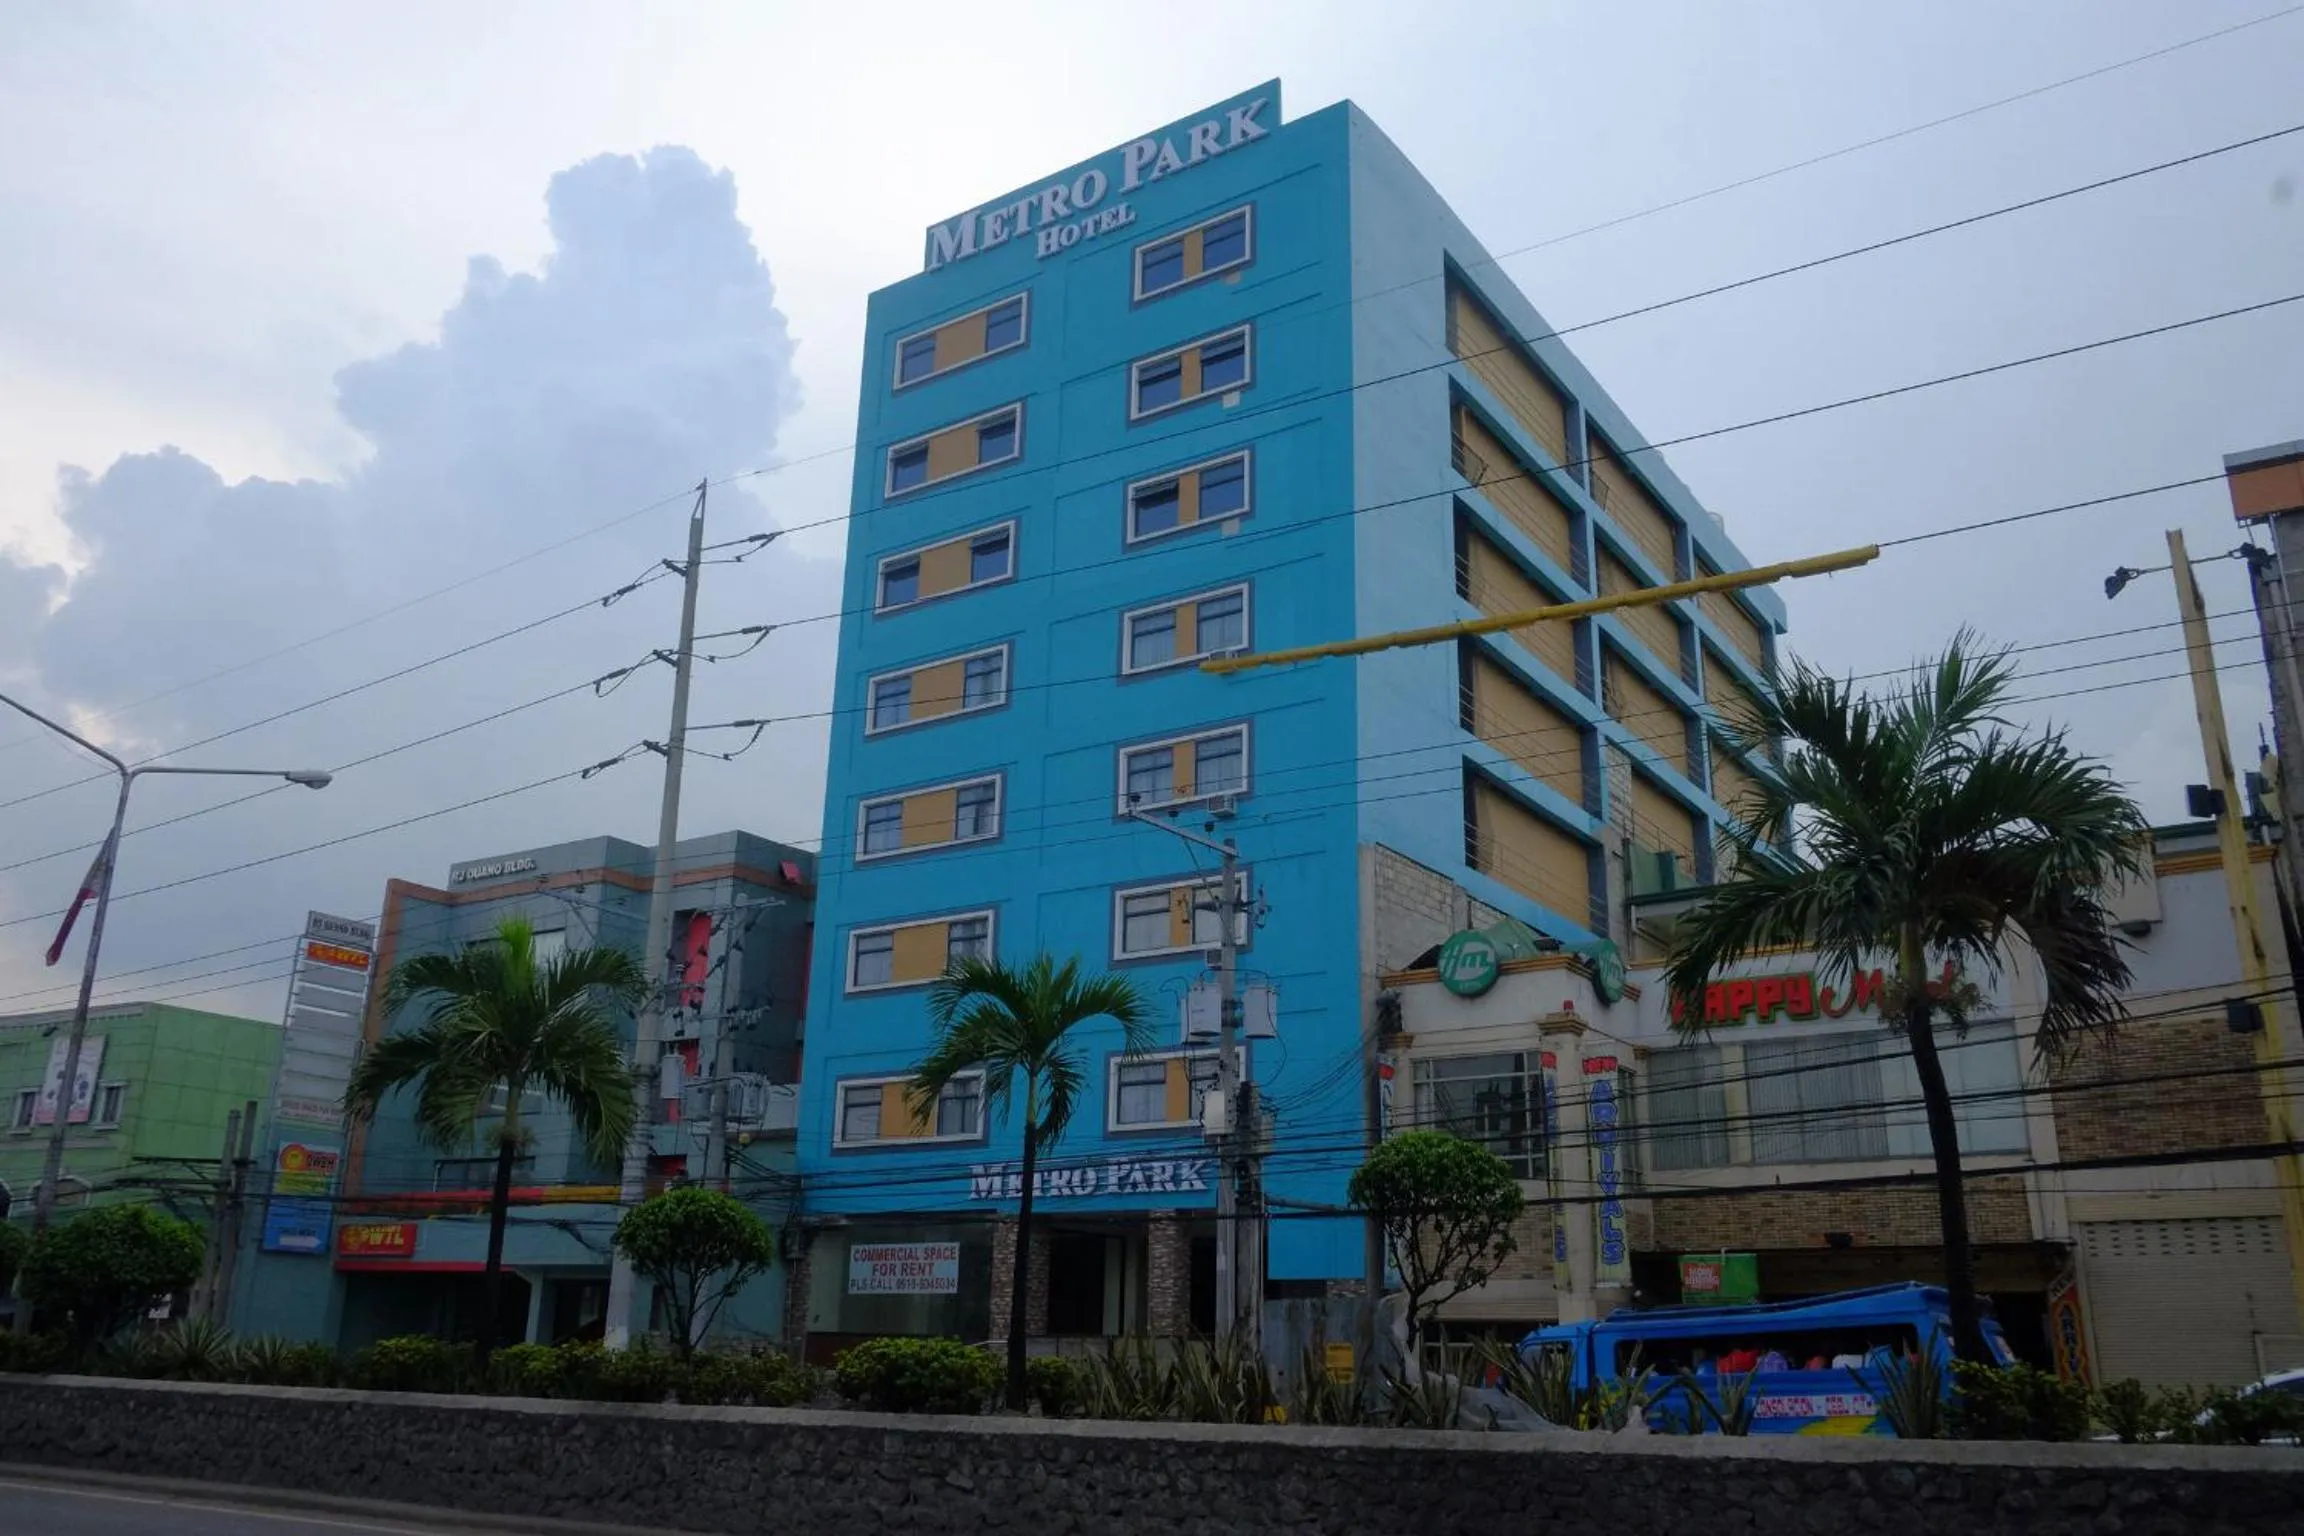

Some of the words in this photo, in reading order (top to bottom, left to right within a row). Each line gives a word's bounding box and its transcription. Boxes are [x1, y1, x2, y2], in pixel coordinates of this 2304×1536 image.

[929, 168, 1108, 270] METRO
[1119, 97, 1270, 195] PARK
[1036, 203, 1137, 260] HOTEL
[969, 1162, 1097, 1202] METRO
[1106, 1157, 1208, 1195] PARK
[853, 1246, 918, 1263] COMMERCIAL
[923, 1245, 957, 1261] SPACE
[872, 1262, 897, 1277] FOR
[901, 1261, 935, 1276] RENT
